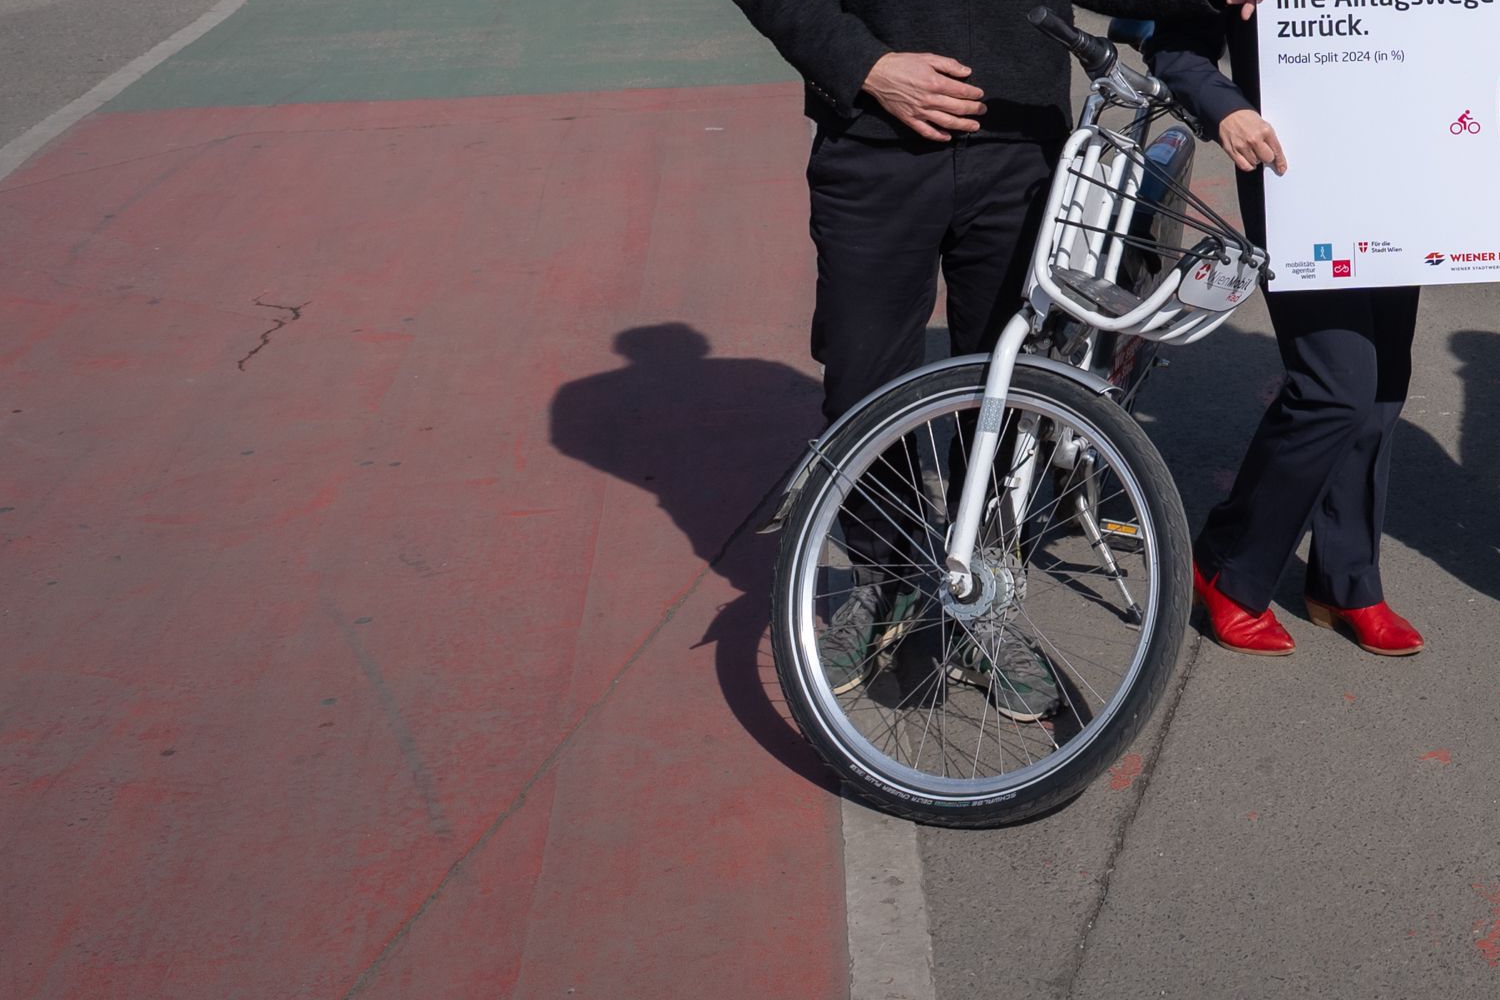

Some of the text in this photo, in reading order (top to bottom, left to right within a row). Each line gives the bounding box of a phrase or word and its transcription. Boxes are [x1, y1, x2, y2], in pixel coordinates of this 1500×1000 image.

[1277, 13, 1369, 38] zurück.
[1278, 50, 1405, 65] Modal Split 2024 (in %)
[1450, 252, 1495, 262] WIENER
[1207, 270, 1253, 291] WienMobil
